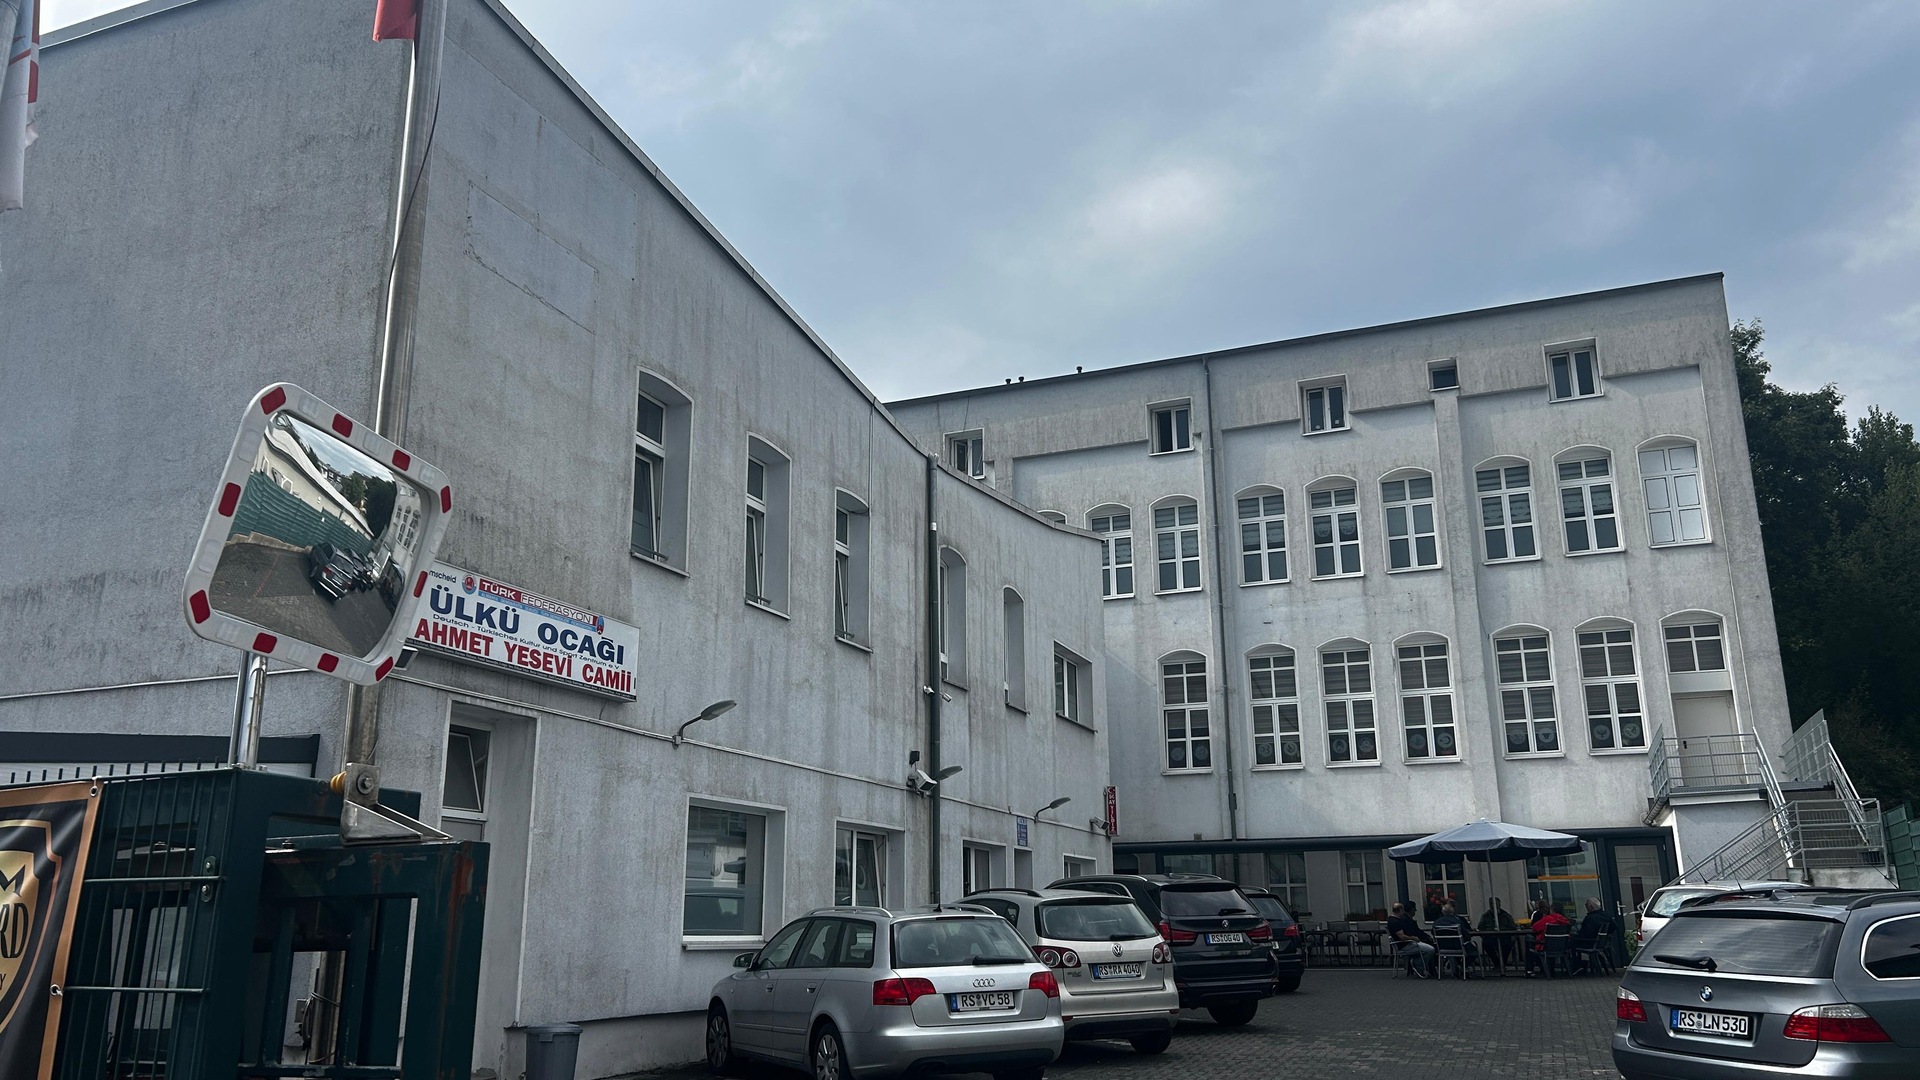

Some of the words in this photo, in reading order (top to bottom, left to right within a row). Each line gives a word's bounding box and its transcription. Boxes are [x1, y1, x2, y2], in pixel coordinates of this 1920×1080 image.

[482, 581, 516, 600] TÜRK
[521, 592, 591, 623] FEDERASYON
[430, 584, 520, 634] ÜLKÜ
[537, 622, 625, 665] OCAĞI
[433, 613, 469, 629] Deutsch
[477, 625, 518, 643] Türkisches
[520, 638, 541, 648] Kultur
[542, 645, 558, 653] und
[559, 649, 578, 660] Sport
[579, 655, 607, 668] Zentrum
[415, 618, 493, 657] AHMET
[504, 641, 572, 677] YESEVİ
[1099, 964, 1109, 976] RS
[1123, 963, 1140, 974] 4040
[961, 994, 976, 1007] RS
[982, 993, 996, 1006] YC
[997, 993, 1010, 1005] 58
[1679, 1012, 1695, 1027] RS
[1703, 1014, 1720, 1030] LN
[1722, 1016, 1747, 1033] 530
